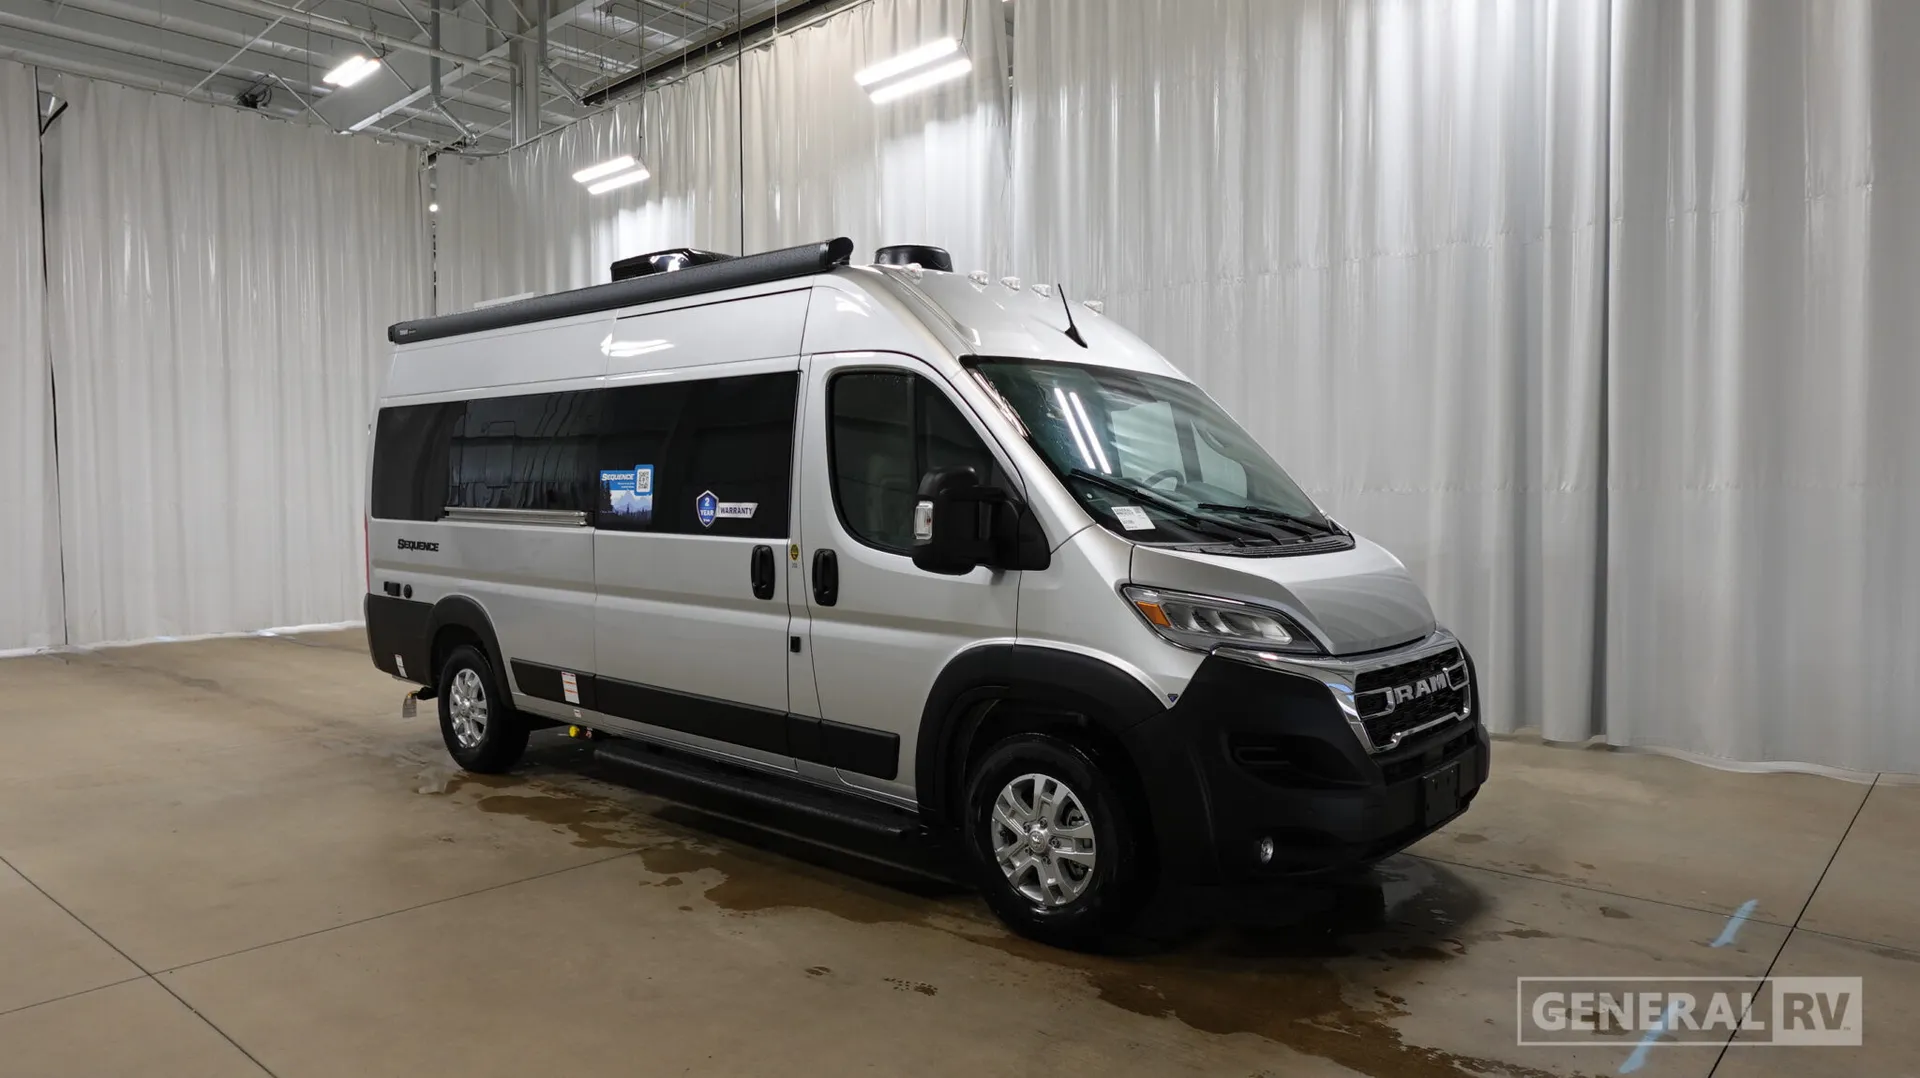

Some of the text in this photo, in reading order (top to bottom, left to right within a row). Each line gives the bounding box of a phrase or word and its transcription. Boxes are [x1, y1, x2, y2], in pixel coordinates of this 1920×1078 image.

[602, 473, 635, 481] SEQUENCE
[704, 497, 710, 507] 2
[700, 509, 715, 517] YEAR
[720, 507, 753, 515] WARRANTY
[397, 538, 440, 552] SEQUENCE
[1394, 673, 1448, 705] RAM
